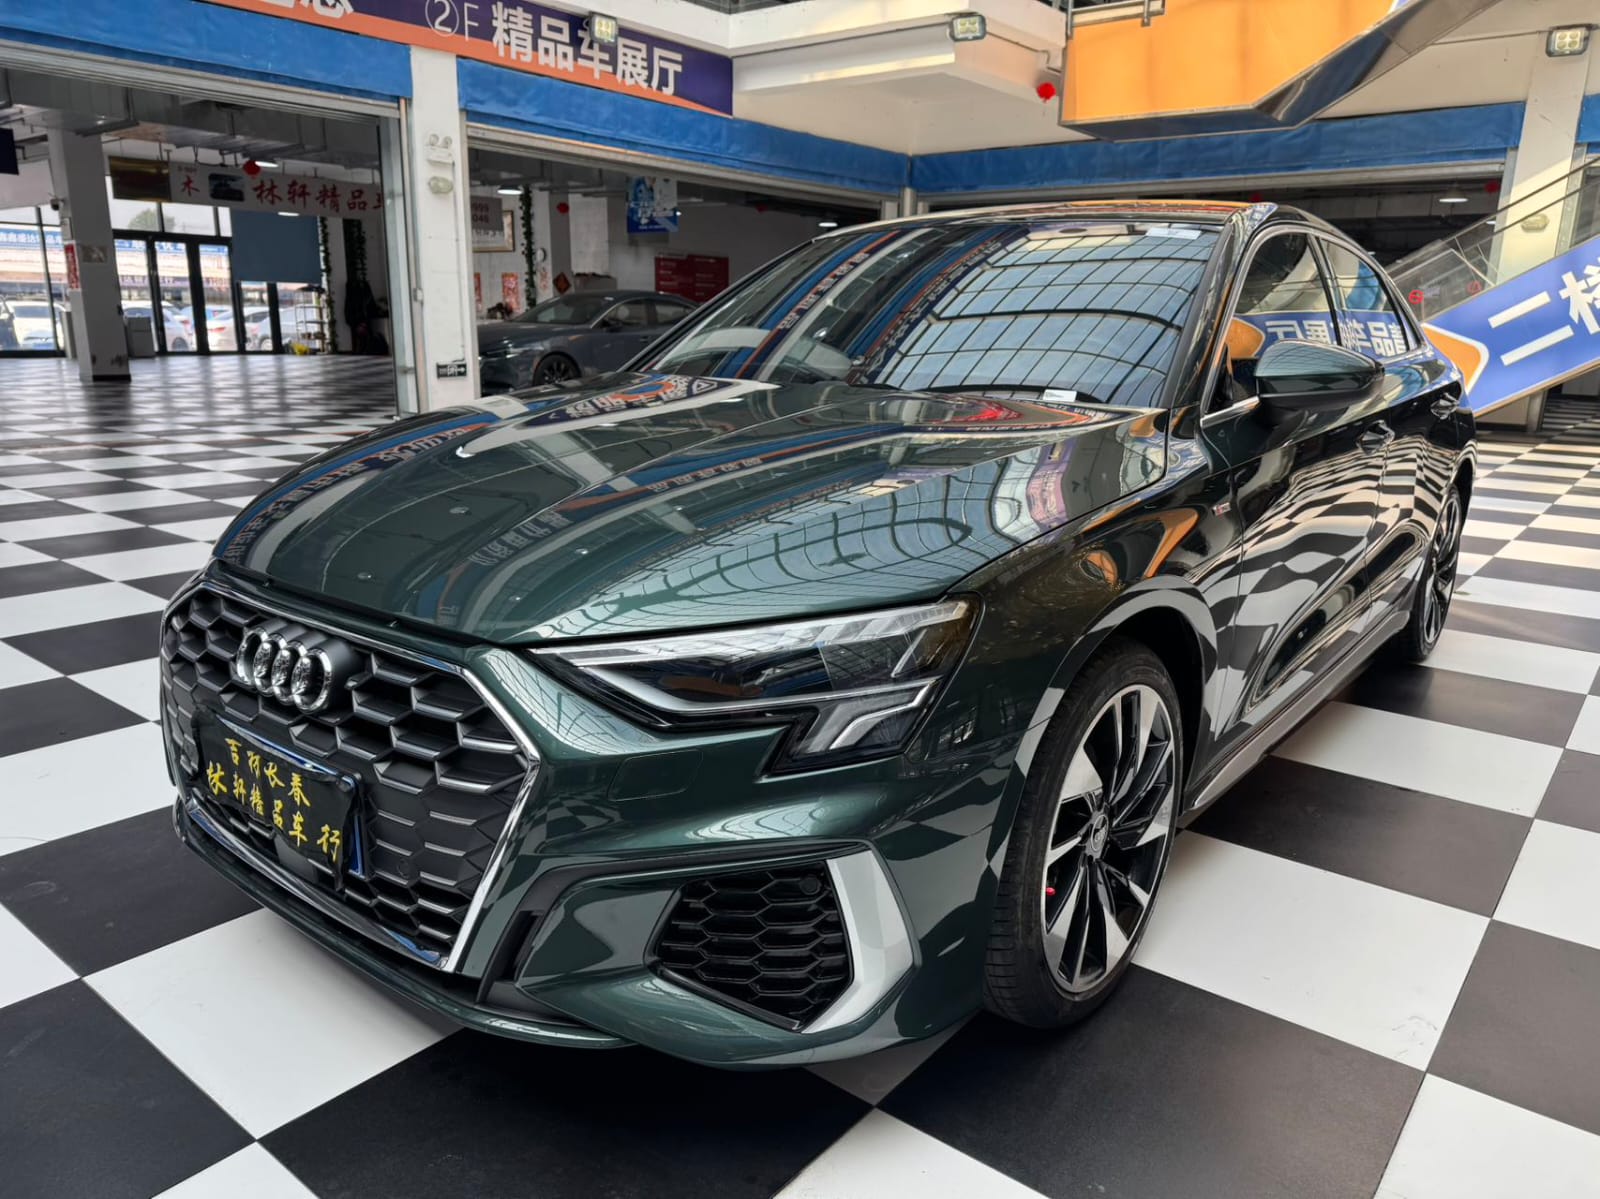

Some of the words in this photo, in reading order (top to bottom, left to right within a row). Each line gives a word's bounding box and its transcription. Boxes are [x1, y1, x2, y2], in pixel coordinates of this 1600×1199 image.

[491, 6, 683, 96] 精品车展厅
